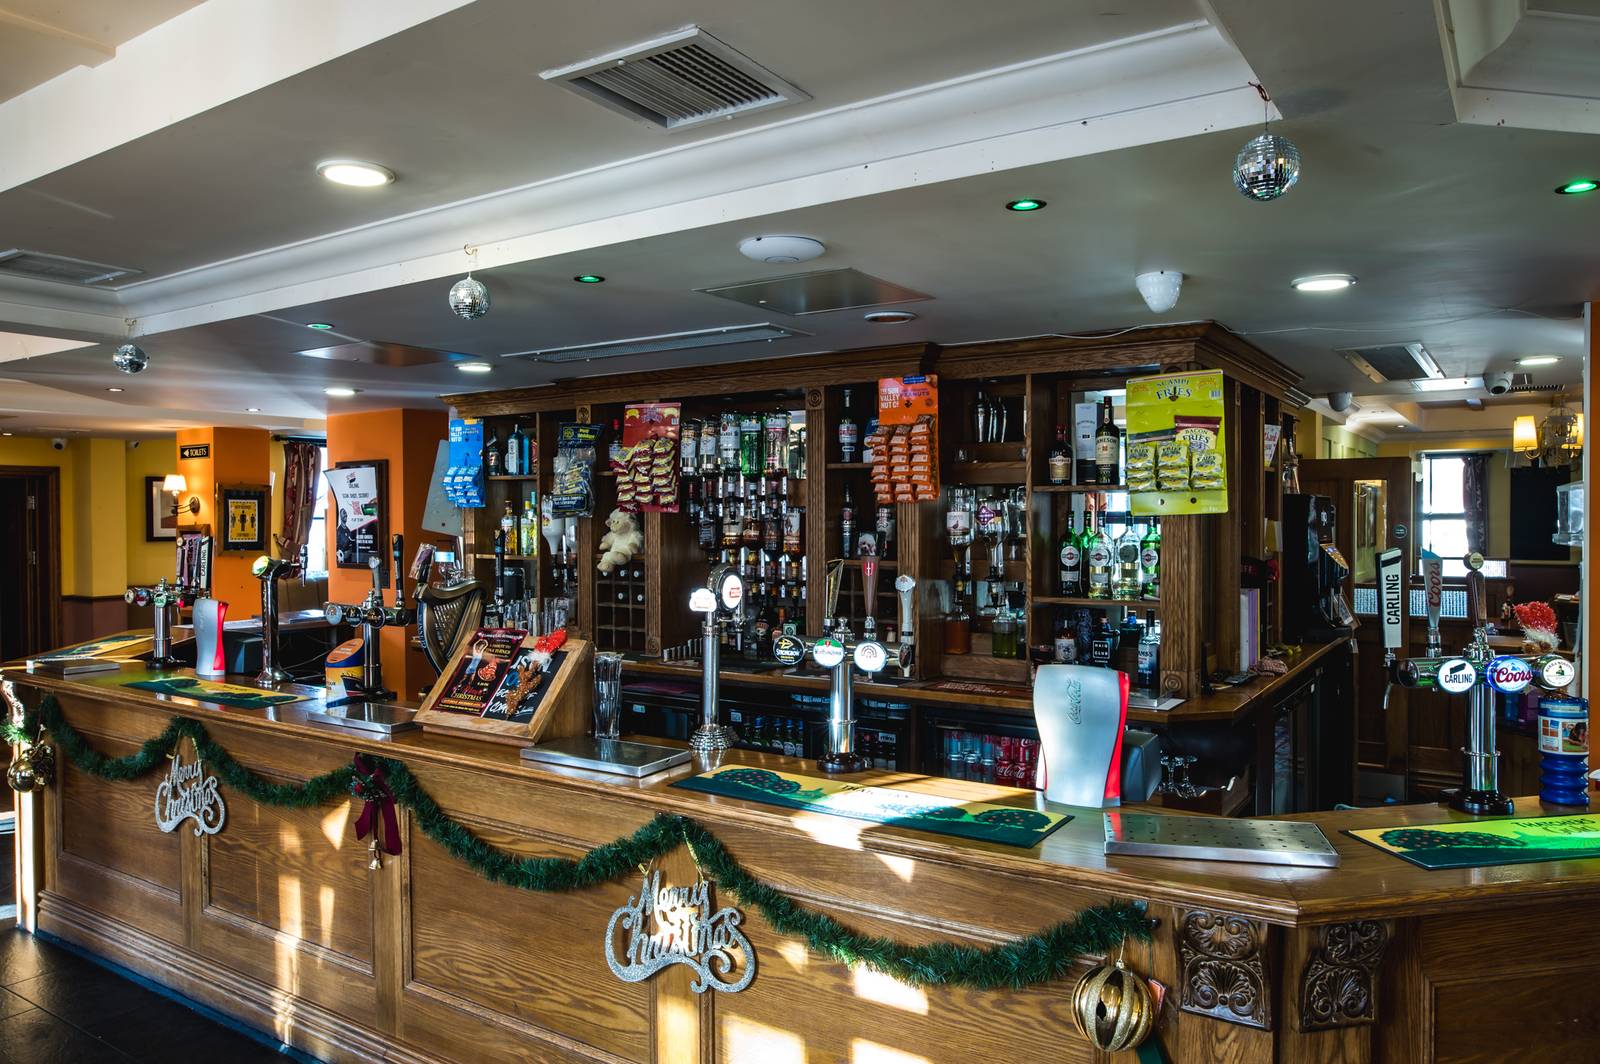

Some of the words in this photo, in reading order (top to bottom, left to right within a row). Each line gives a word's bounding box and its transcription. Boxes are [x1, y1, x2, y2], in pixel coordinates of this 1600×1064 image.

[1157, 378, 1190, 387] SCAMPI
[880, 394, 899, 403] VALLEY
[1182, 434, 1211, 444] FRIES
[1185, 427, 1209, 435] BACON
[1429, 562, 1440, 608] Coors
[1386, 574, 1400, 625] CARLING
[1444, 674, 1473, 684] CARLING
[1495, 667, 1533, 684] Coors
[155, 774, 226, 836] Christmas
[627, 869, 711, 922] Merry
[604, 896, 756, 993] Christmas
